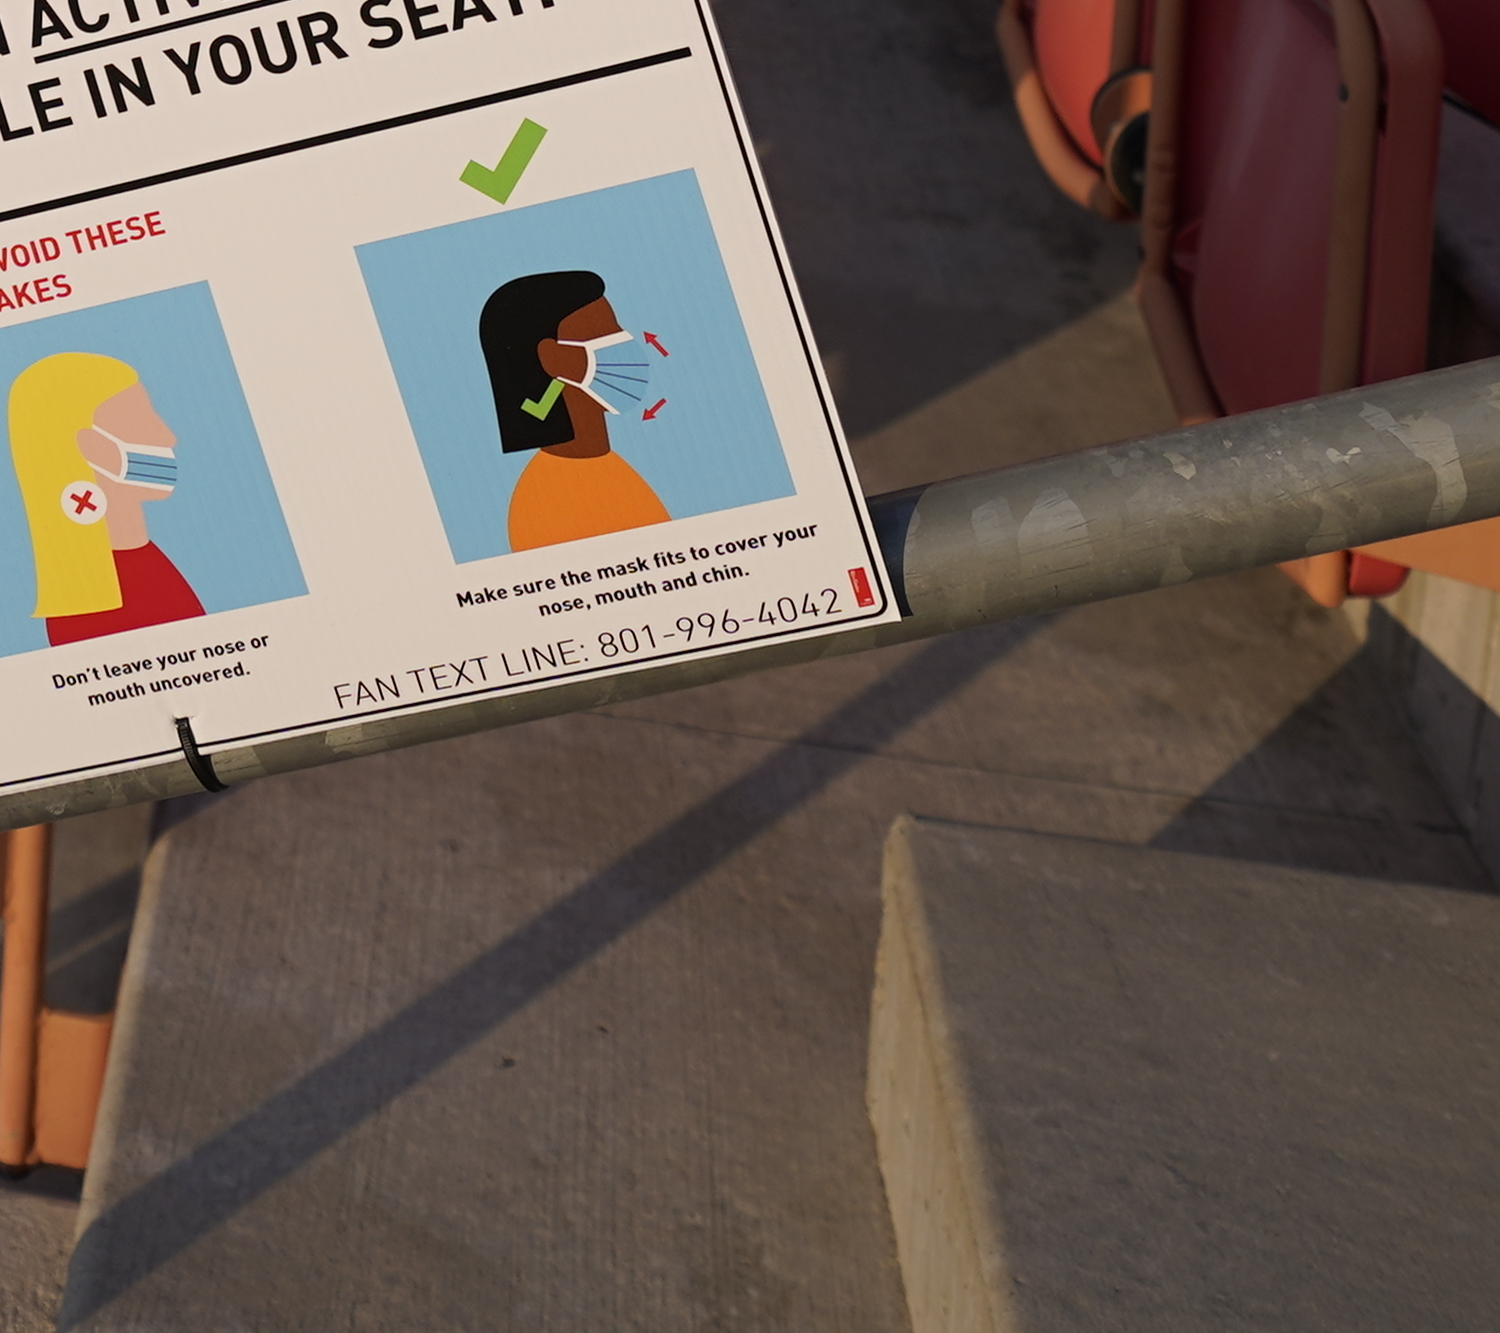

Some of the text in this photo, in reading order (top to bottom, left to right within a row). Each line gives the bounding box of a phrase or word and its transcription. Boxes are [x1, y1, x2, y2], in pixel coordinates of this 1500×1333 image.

[82, 55, 156, 119] IN
[161, 10, 349, 96] YOUR
[64, 209, 166, 254] THESE
[455, 523, 817, 608] Make sure the mask fits to cover your
[537, 563, 750, 617] nose, mouth and chin.
[51, 634, 269, 689] Don't leave your nose or
[332, 674, 400, 709] FAN
[405, 655, 488, 694] TEXT
[499, 638, 588, 677] LINE:
[596, 587, 842, 658] 801-996-4042
[87, 660, 251, 706] mouth uncovered.
